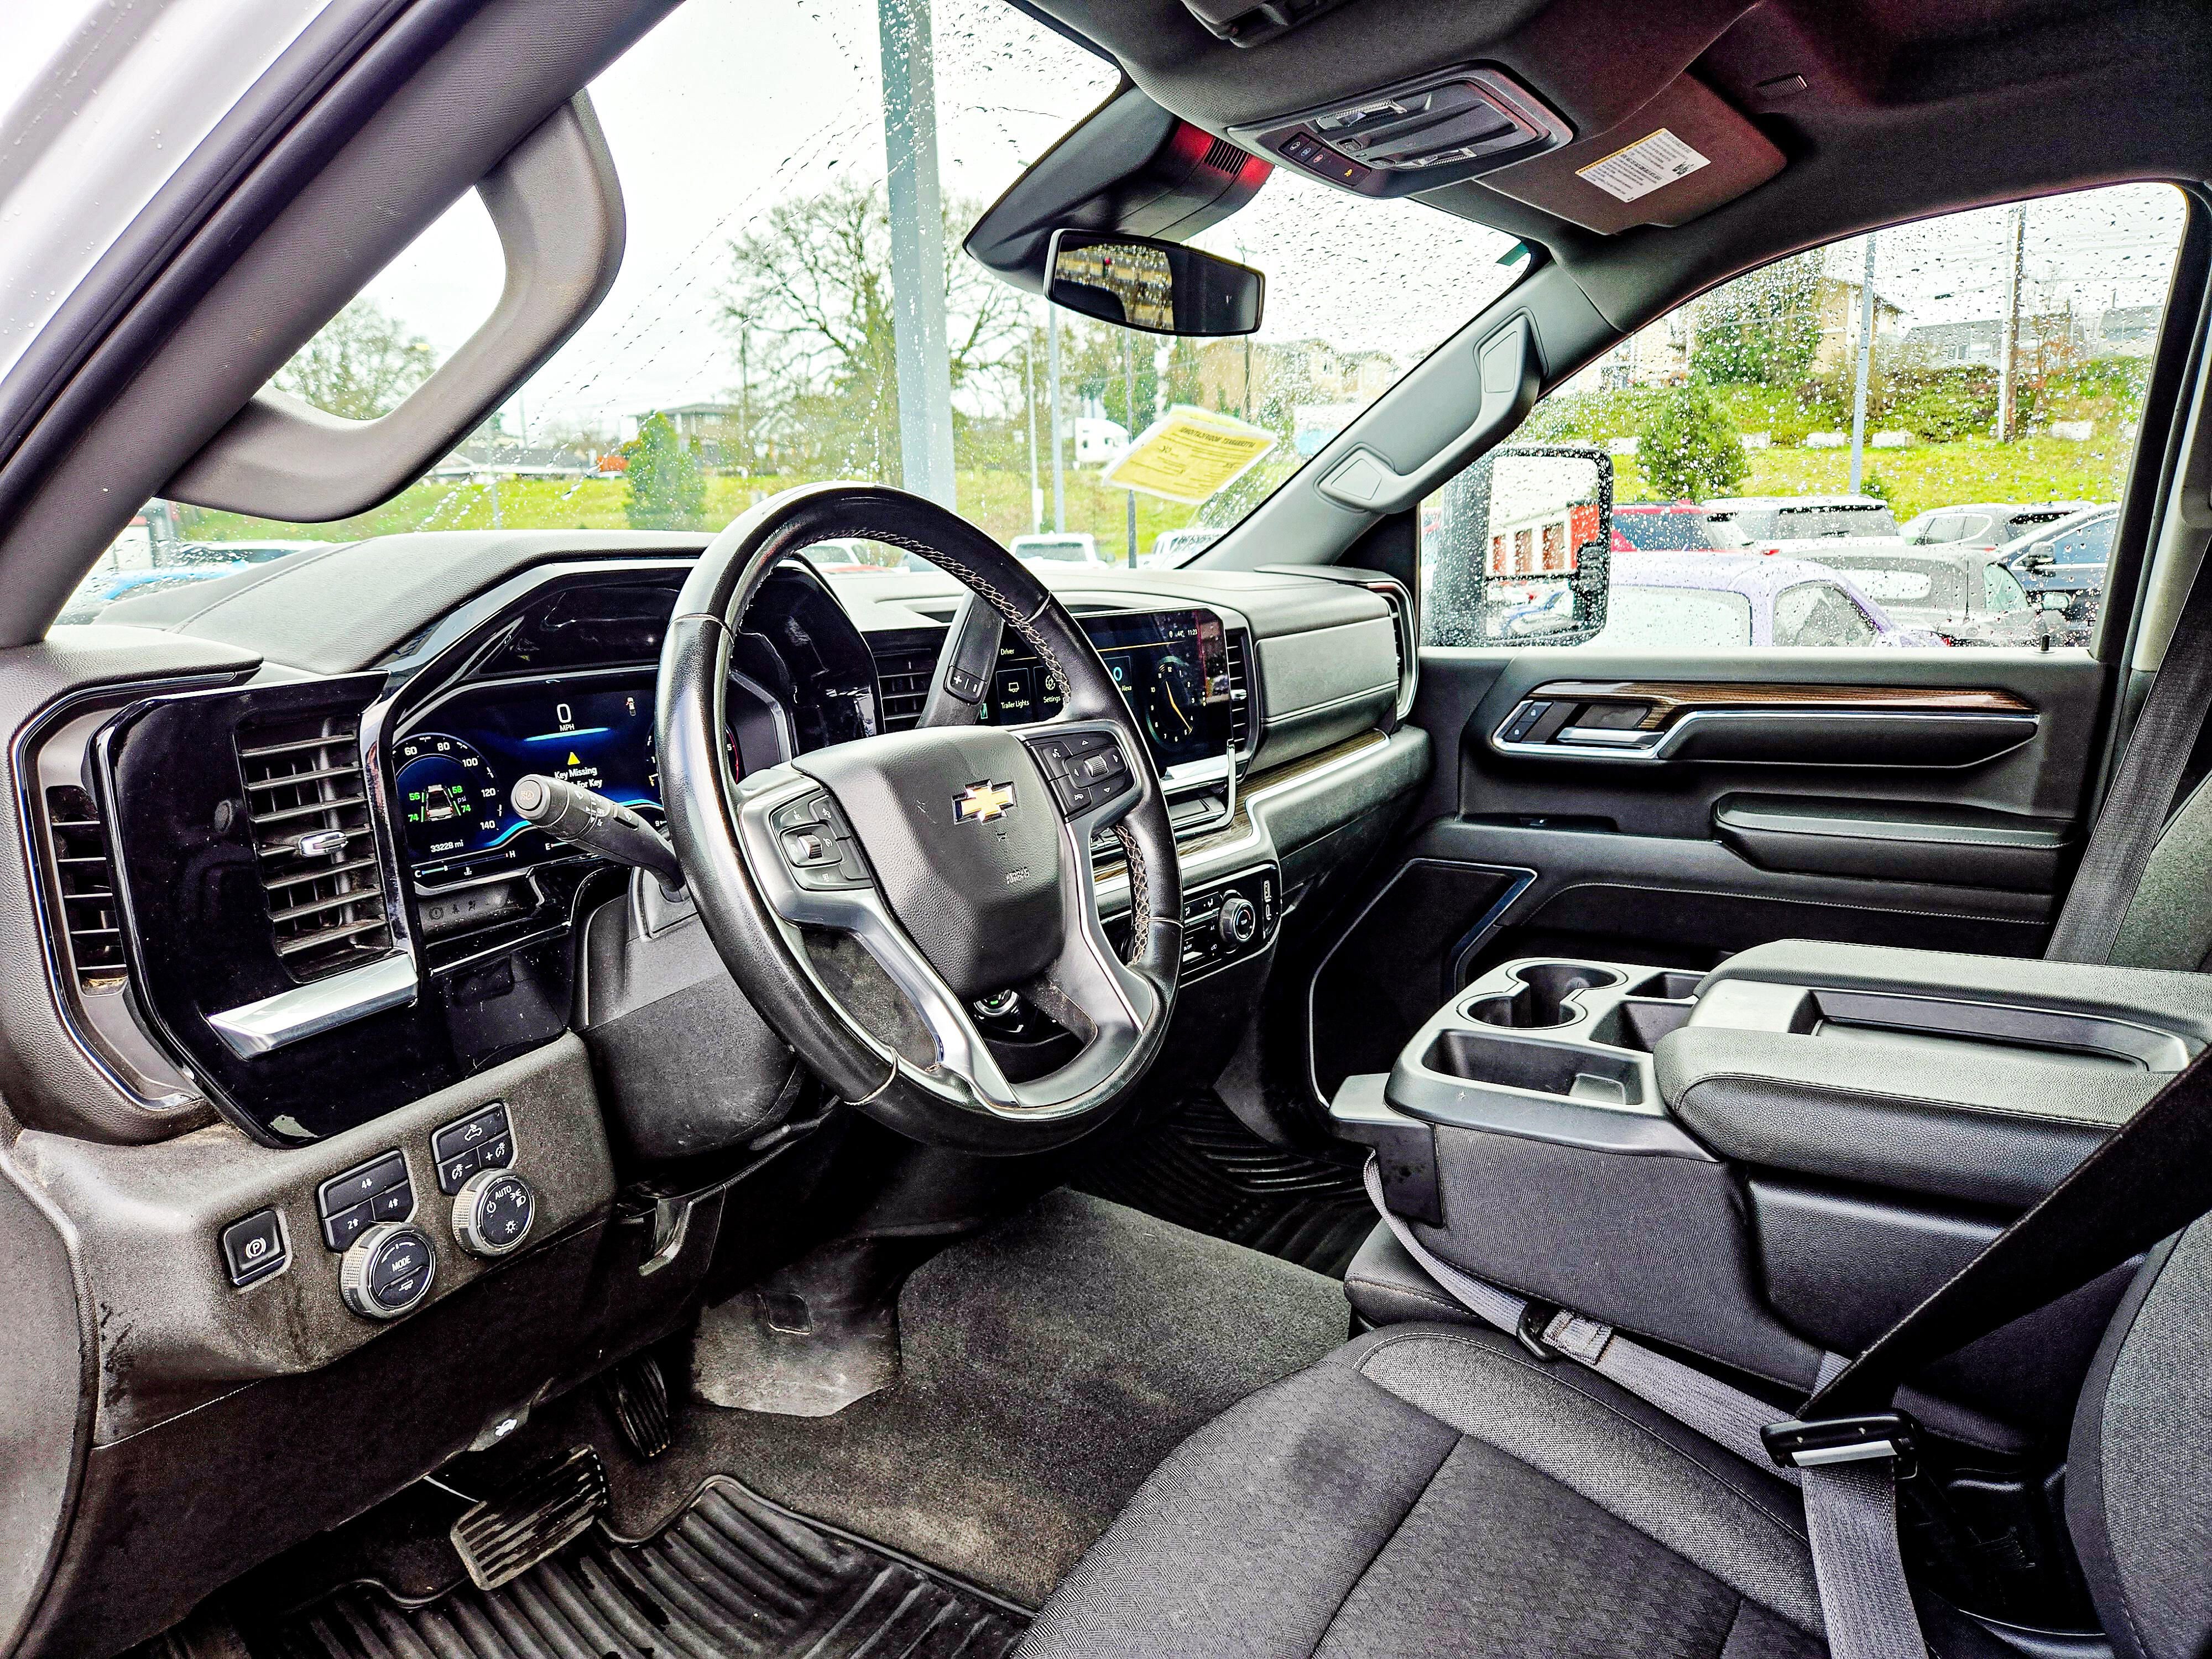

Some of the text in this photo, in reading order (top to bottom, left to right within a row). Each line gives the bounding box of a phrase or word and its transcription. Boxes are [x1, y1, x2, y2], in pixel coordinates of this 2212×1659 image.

[1015, 699, 1030, 708] Lights
[1043, 695, 1061, 703] Settings
[556, 703, 572, 723] 0
[559, 723, 575, 732] MPH
[404, 746, 418, 756] 60
[437, 742, 451, 752] 80
[462, 758, 478, 768] 100
[554, 766, 598, 781] Key Missing
[588, 779, 603, 789] Key
[409, 792, 421, 801] 56
[481, 787, 496, 798] 120
[457, 795, 467, 804] psi
[461, 805, 471, 813] 74
[408, 813, 419, 822] 74
[479, 820, 495, 830] 140
[430, 839, 464, 853] 33228 mi
[495, 1185, 512, 1200] AUTO
[392, 1255, 411, 1272] MODE
